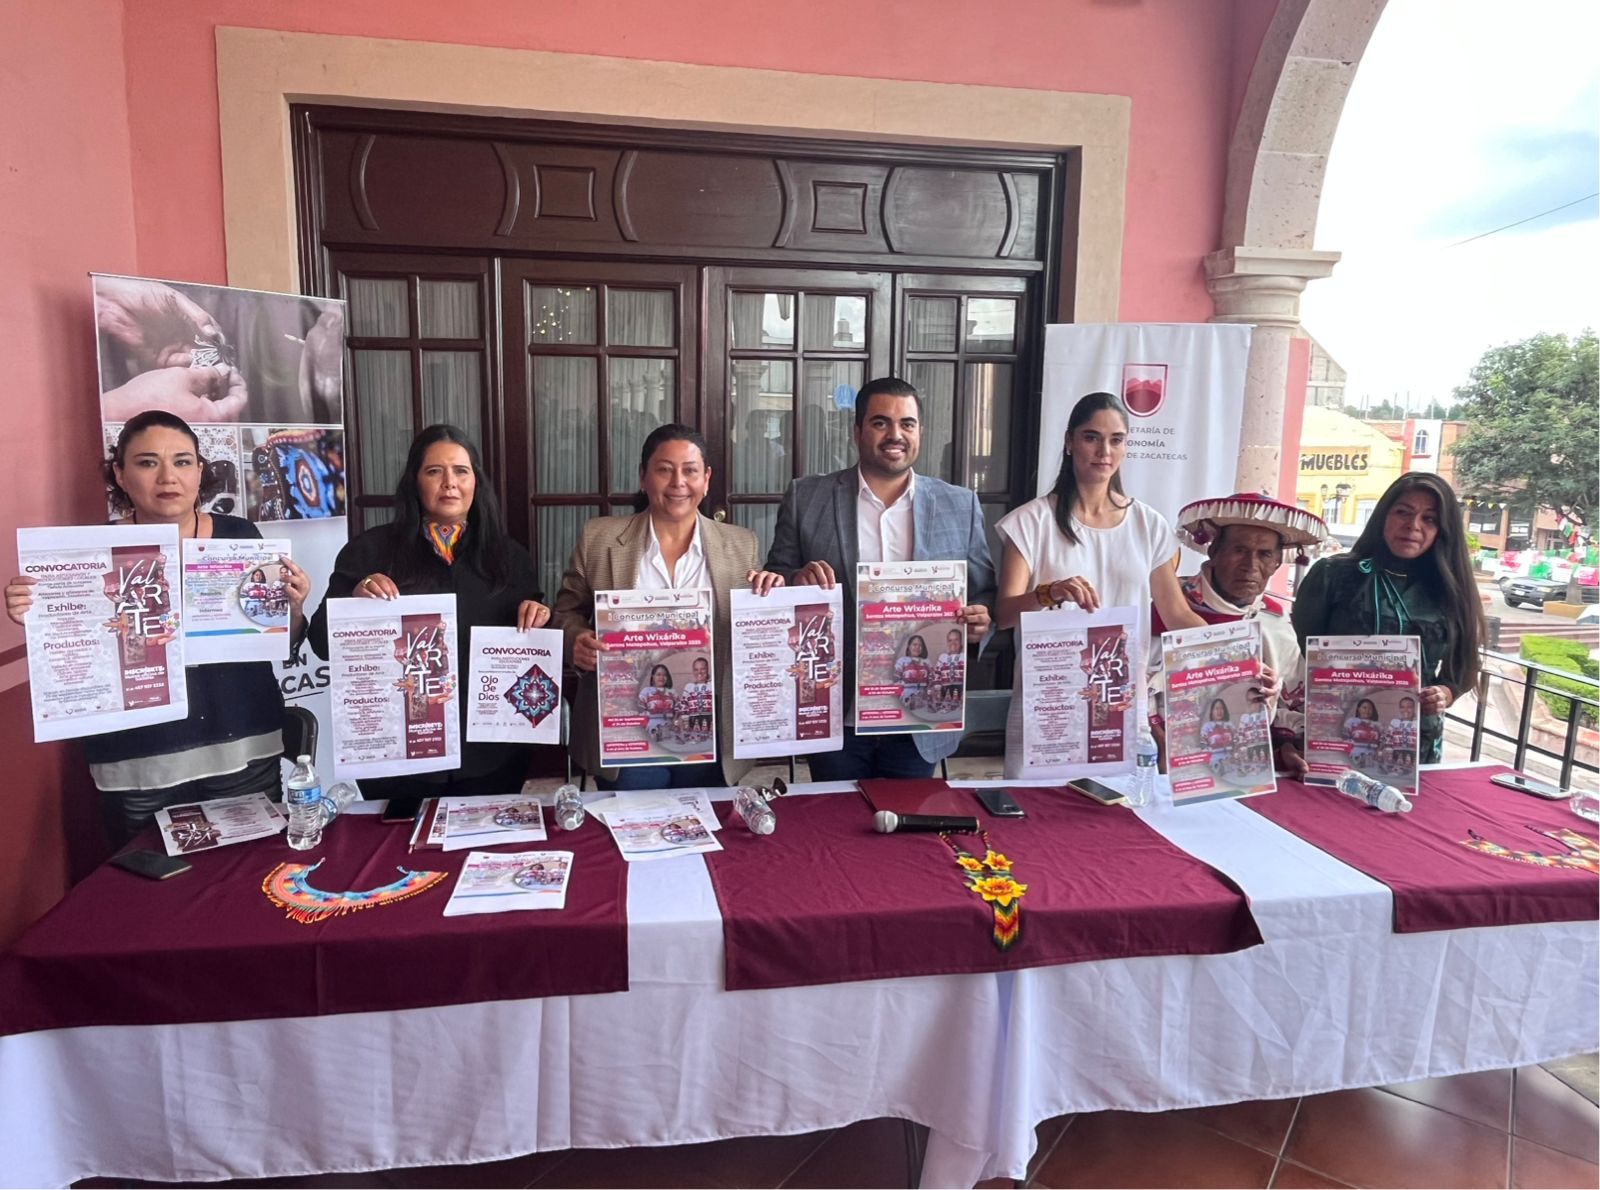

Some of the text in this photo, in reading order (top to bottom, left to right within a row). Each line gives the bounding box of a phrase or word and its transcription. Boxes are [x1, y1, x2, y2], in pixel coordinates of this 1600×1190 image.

[1162, 427, 1176, 435] DE
[1139, 452, 1188, 460] ZACATECAS
[1300, 453, 1368, 471] MUEBLES
[25, 562, 107, 573] CONVOCATORIA
[47, 602, 87, 613] Exhibe:
[882, 604, 942, 613] Arte Wixárika
[657, 610, 699, 620] Municipal
[735, 618, 791, 627] CONVOCATORIA
[332, 628, 398, 638] CONVOCATORIA
[624, 632, 687, 642] Arte Wixárika
[43, 639, 100, 651] Productos:
[1026, 640, 1084, 650] CONVOCATORIA
[482, 647, 552, 657] CONVOCATORIA
[348, 664, 381, 673] Exhibe:
[480, 675, 499, 685] Ojo
[1186, 671, 1203, 680] Arte
[1331, 671, 1351, 679] Arte
[1352, 671, 1394, 680] Wixárika
[482, 684, 497, 692] De
[343, 696, 390, 705] Productos:
[478, 692, 500, 701] Dios
